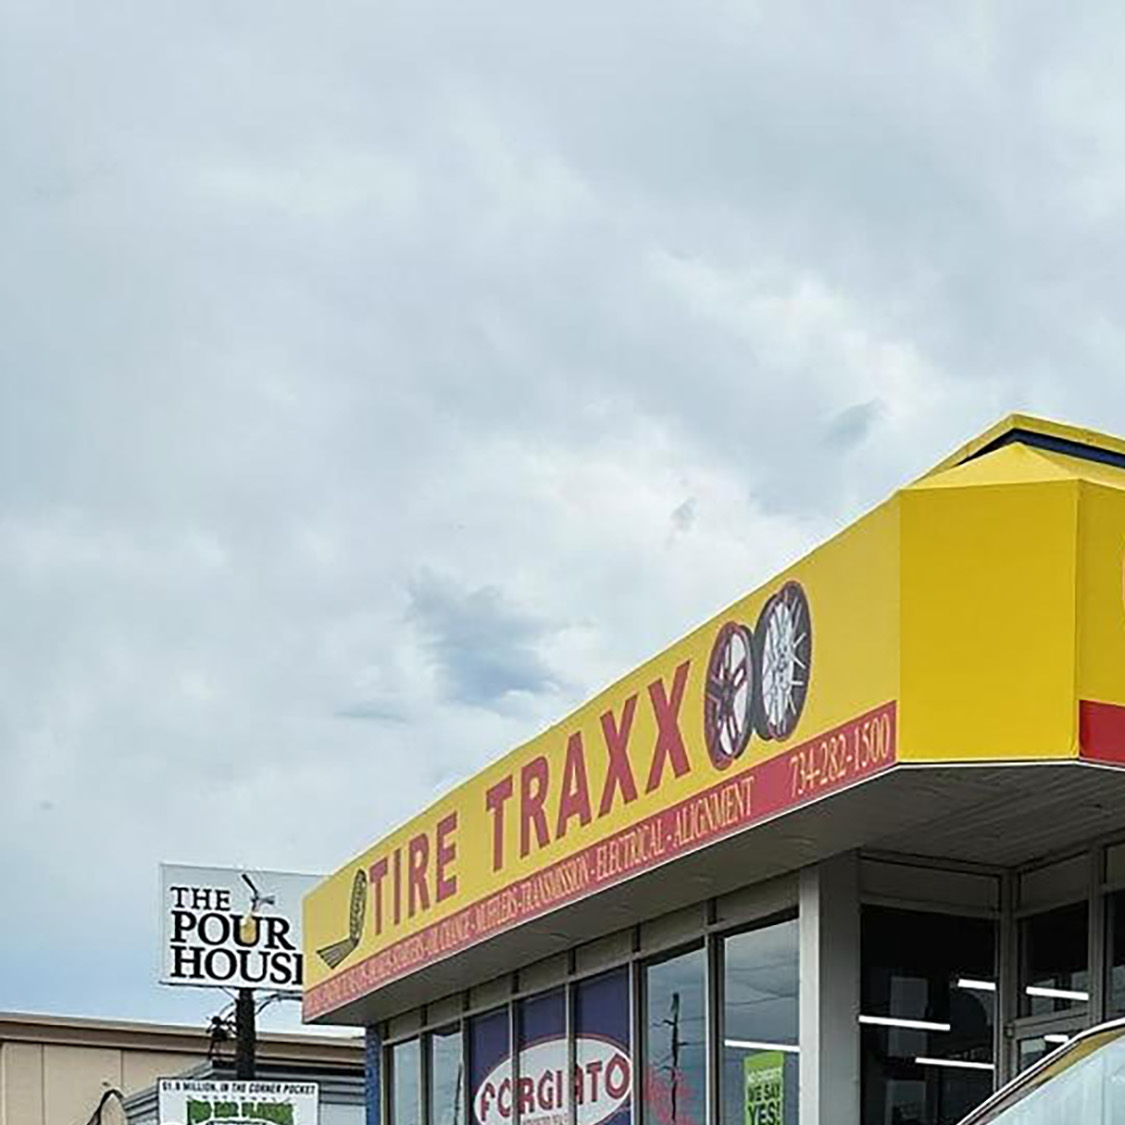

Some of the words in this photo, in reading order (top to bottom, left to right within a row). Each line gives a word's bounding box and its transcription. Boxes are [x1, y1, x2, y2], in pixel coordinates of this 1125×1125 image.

[789, 713, 891, 798] 734-282-1500
[370, 811, 458, 936] TIRE
[485, 660, 691, 873] TRAXX
[672, 776, 755, 848] ALIGNMENT
[170, 886, 231, 911] THE
[170, 910, 296, 951] POUR
